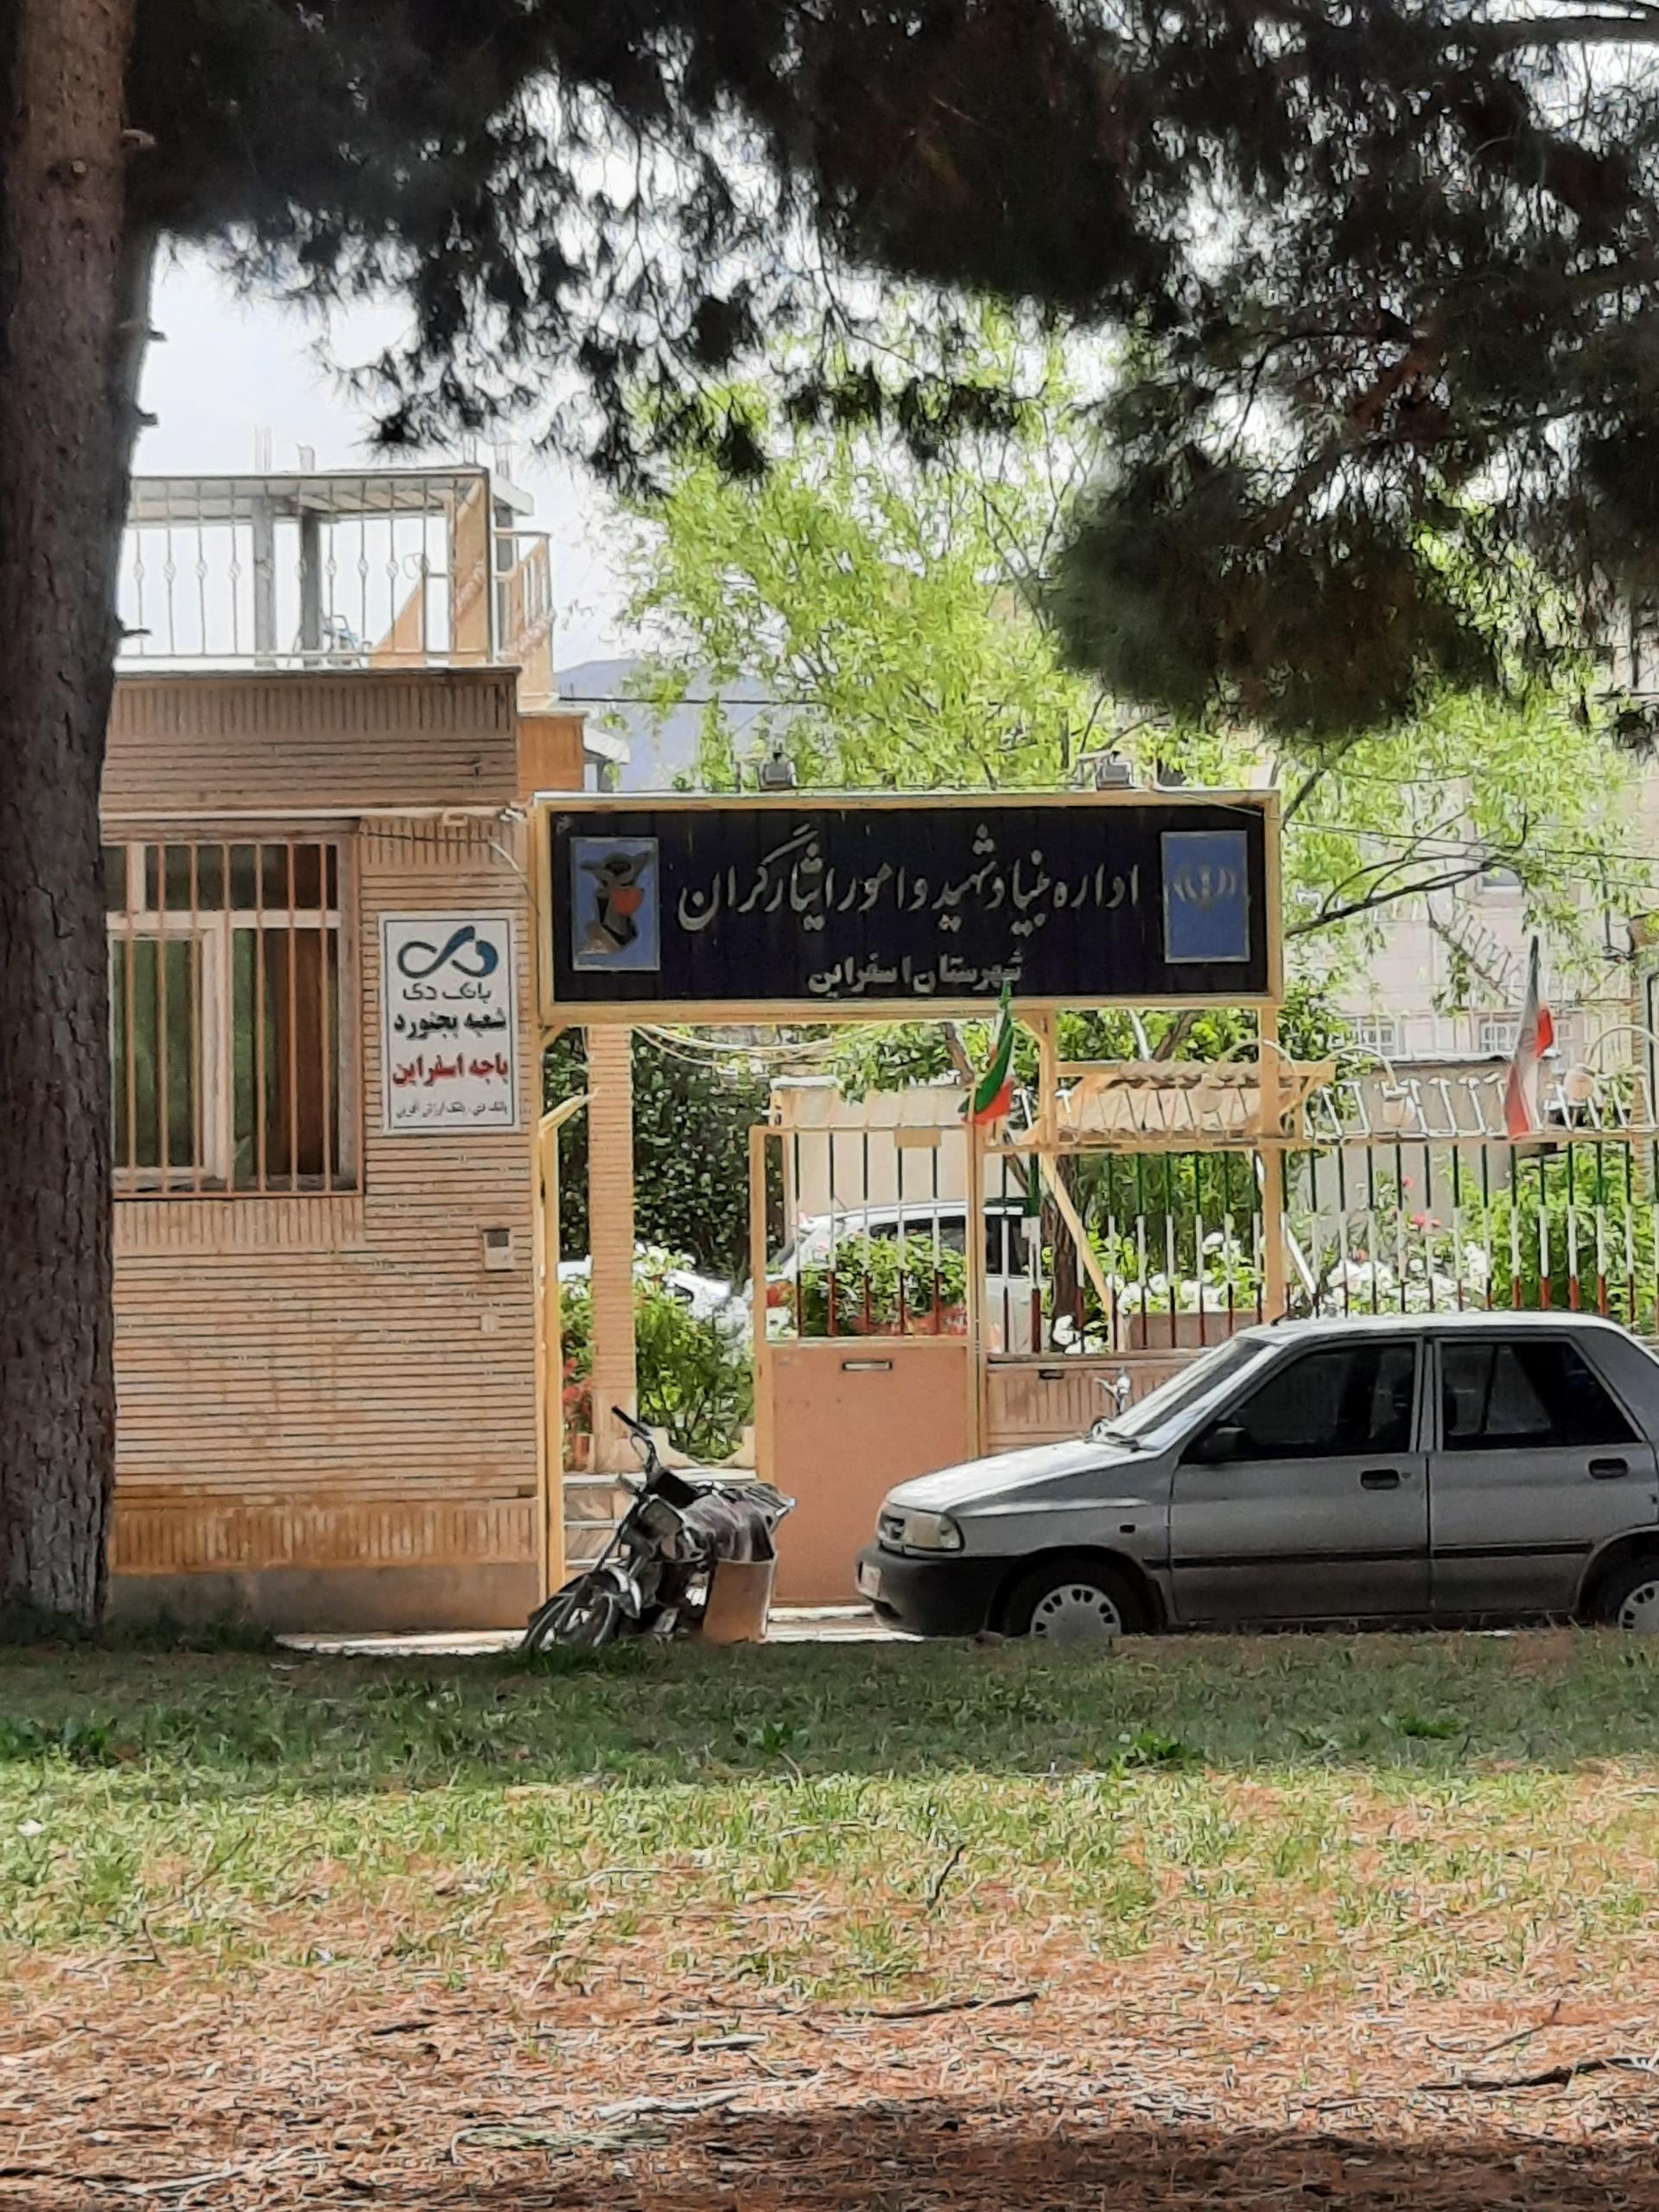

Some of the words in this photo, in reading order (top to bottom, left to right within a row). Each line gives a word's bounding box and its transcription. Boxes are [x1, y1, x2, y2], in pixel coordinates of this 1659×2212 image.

[677, 823, 836, 932] ایثارگران
[836, 861, 906, 912] امور
[907, 877, 928, 912] و
[931, 823, 997, 933] شهید
[985, 849, 1052, 938] بنیاد
[1053, 863, 1139, 908] اداره
[403, 982, 437, 1001] دی
[442, 982, 492, 1004] بانک
[808, 951, 912, 998] اسفراین
[912, 948, 1024, 994] شهرستان
[394, 1011, 459, 1040] بجنورد
[391, 1052, 464, 1088] اسفراین
[469, 1052, 509, 1084] باجه
